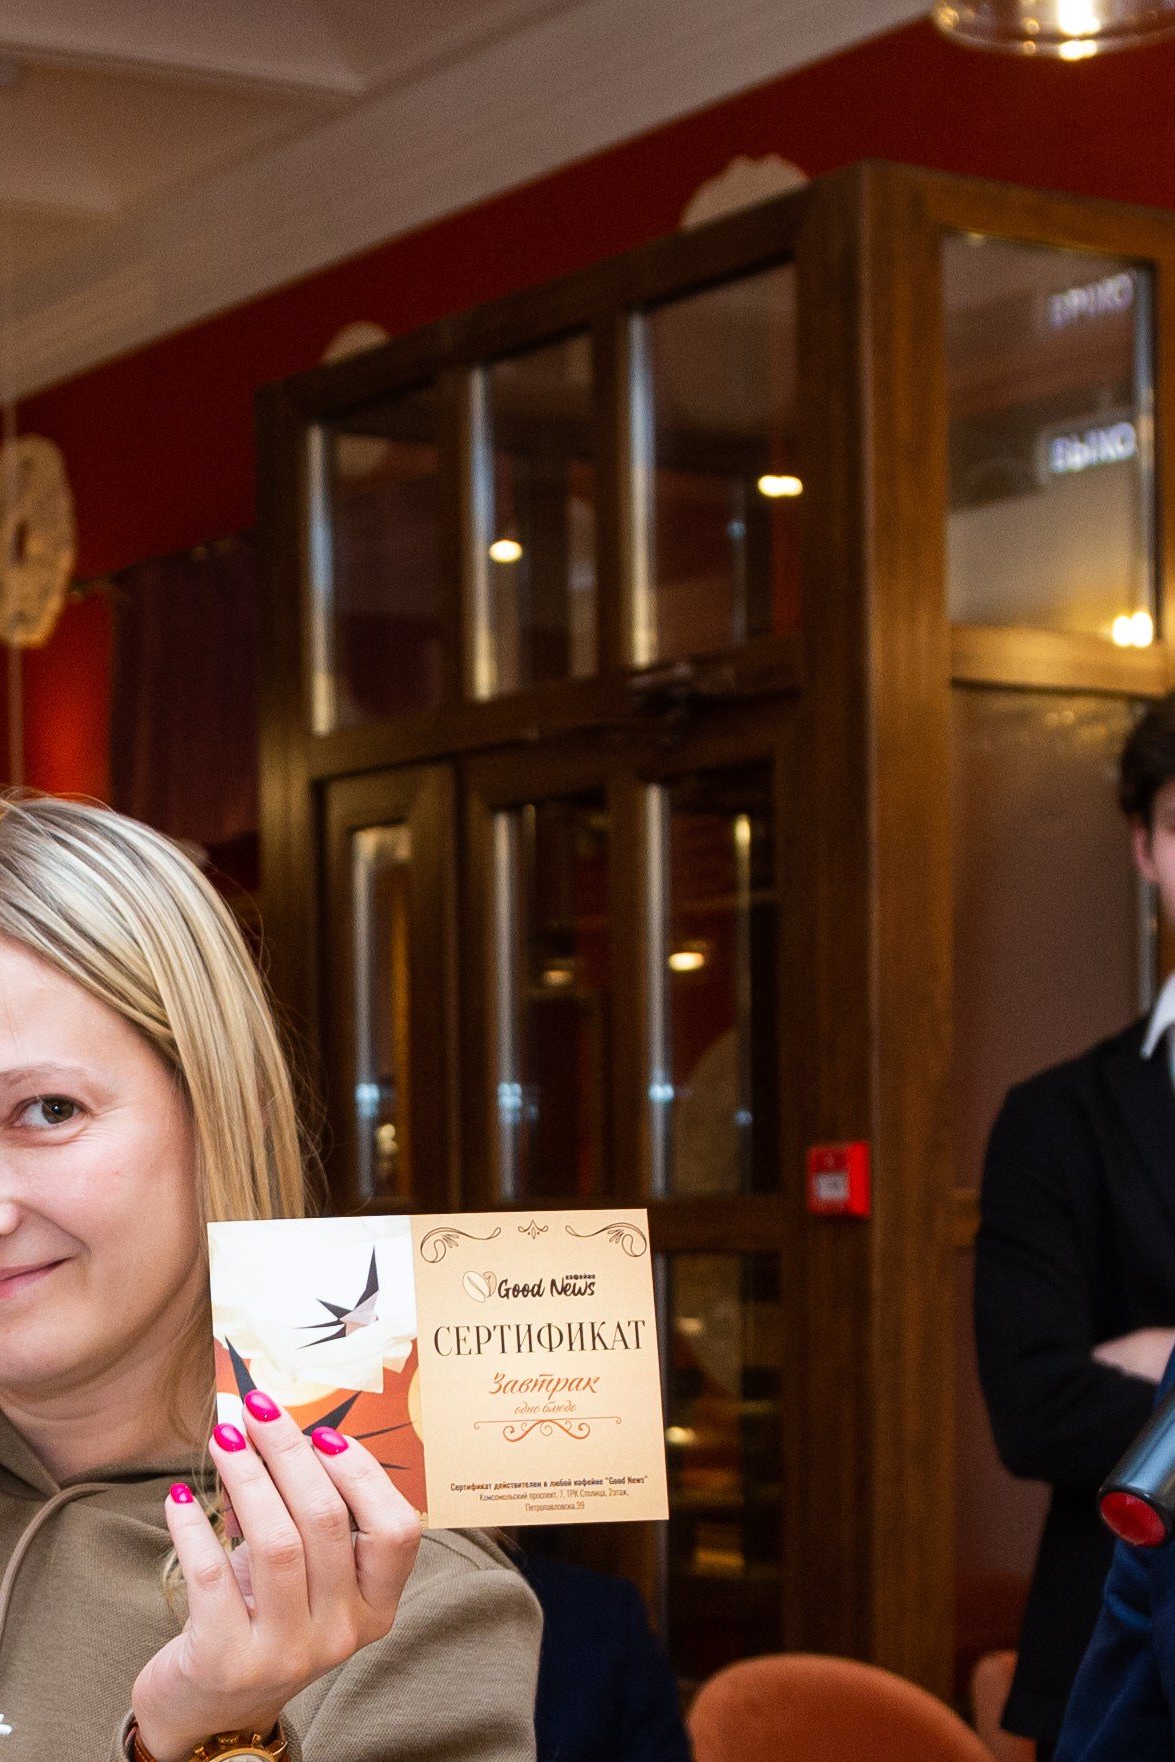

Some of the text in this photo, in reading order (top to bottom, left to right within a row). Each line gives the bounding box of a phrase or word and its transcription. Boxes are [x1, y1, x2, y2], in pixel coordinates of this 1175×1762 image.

[497, 1277, 596, 1299] Good News
[433, 1319, 646, 1357] СЕРТИФИКАТ
[488, 1372, 600, 1400] Завтрак
[514, 1400, 577, 1414] одно блюдо
[450, 1483, 492, 1492] Сертификат
[493, 1481, 542, 1490] действителен
[550, 1478, 572, 1487] любой
[574, 1477, 604, 1487] кофейне
[605, 1476, 626, 1485] "Good
[628, 1475, 649, 1484] News"
[479, 1493, 528, 1501] Комсомольский
